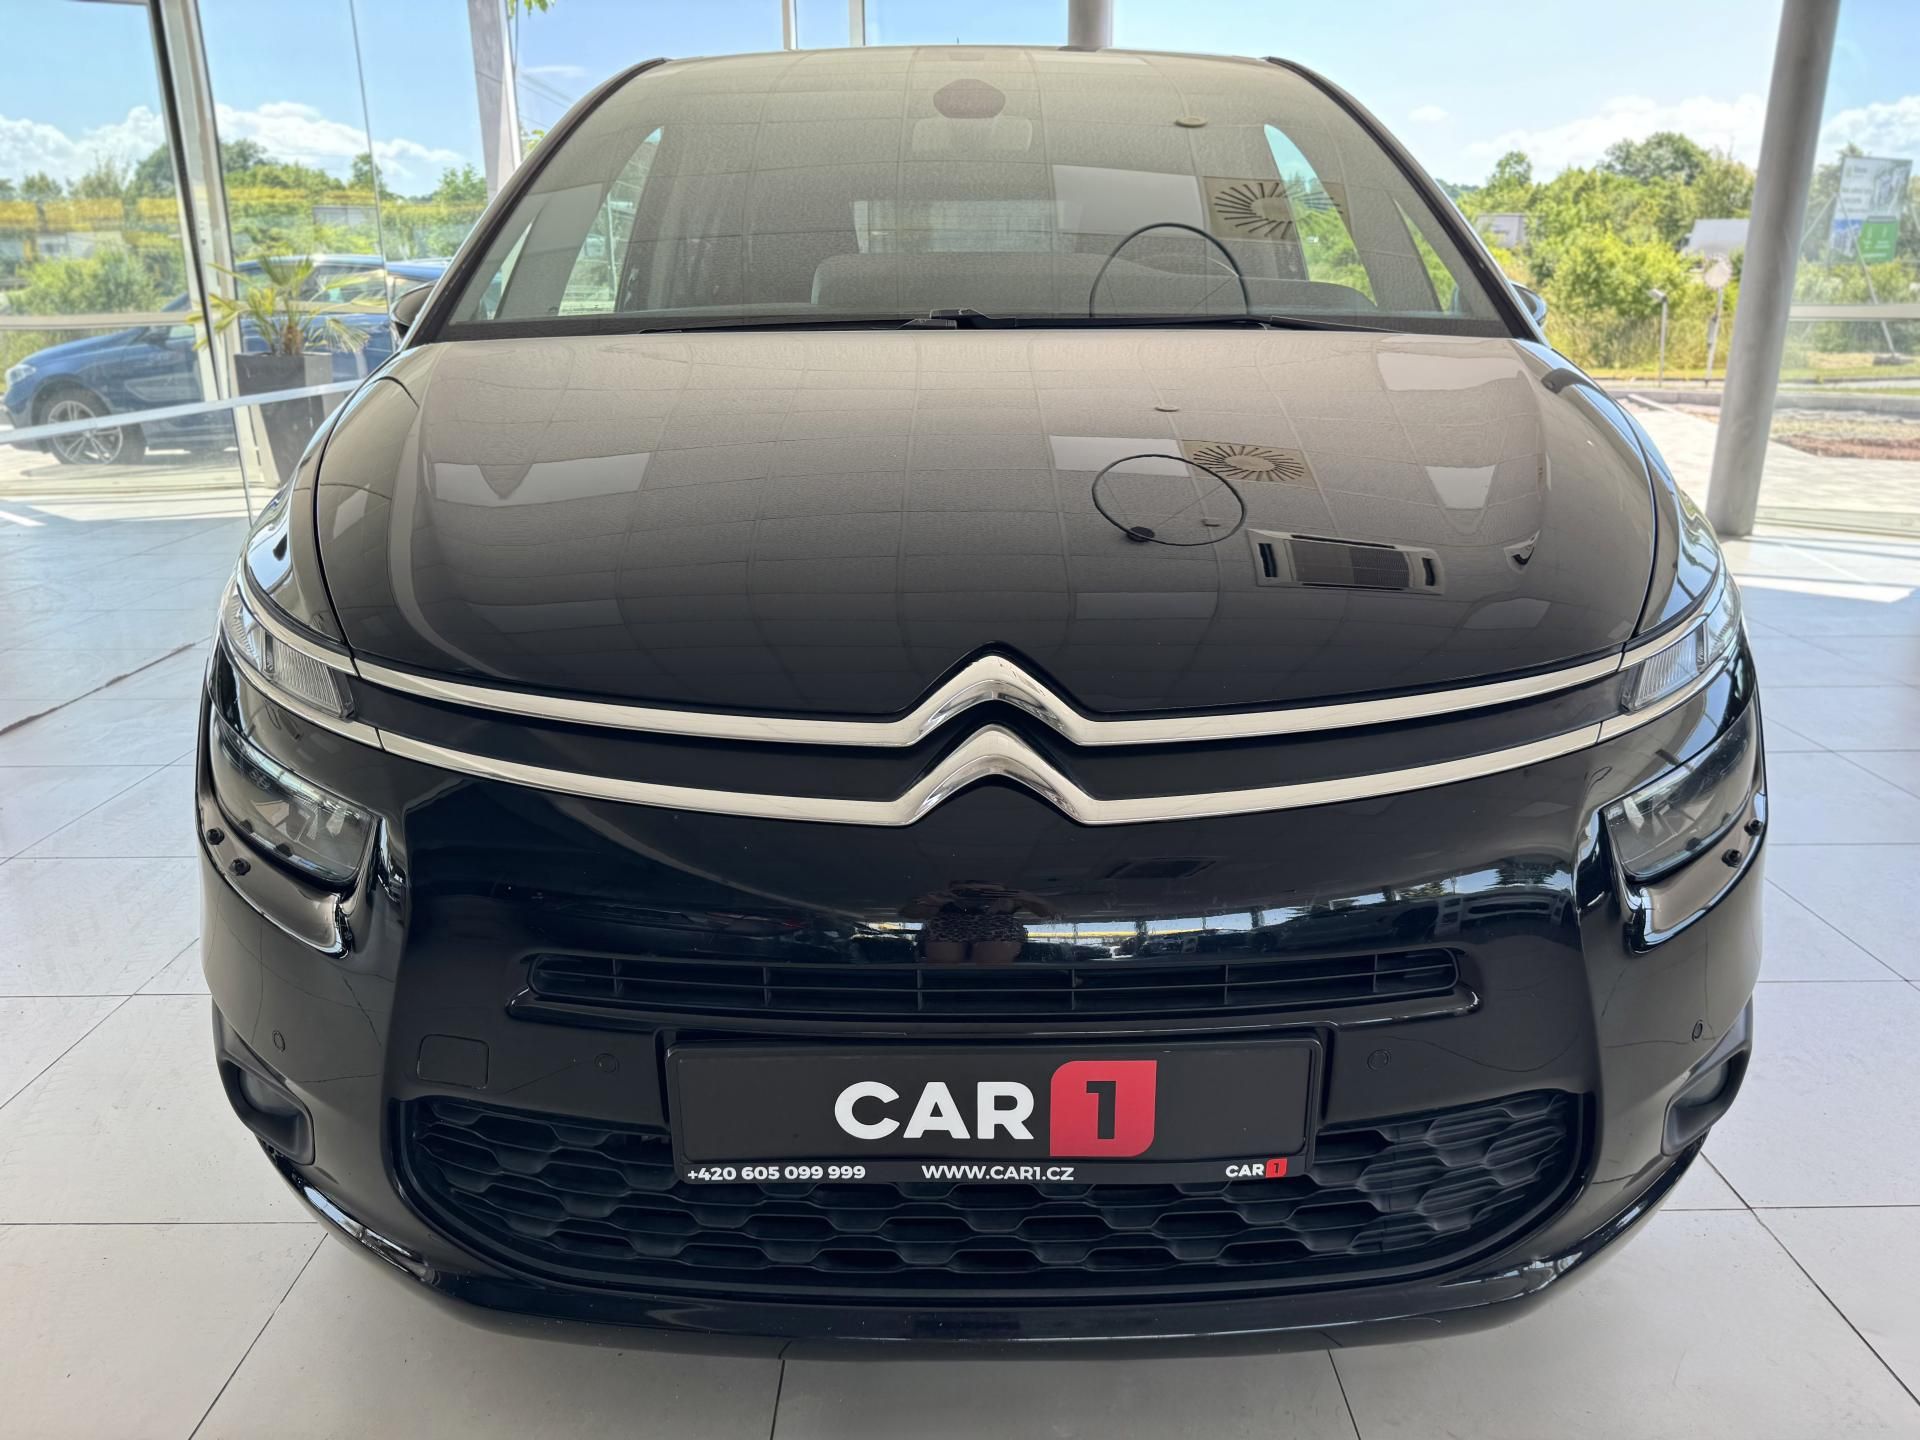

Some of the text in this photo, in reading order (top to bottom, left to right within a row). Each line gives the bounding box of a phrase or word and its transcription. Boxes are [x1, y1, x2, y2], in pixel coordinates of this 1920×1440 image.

[834, 1080, 1117, 1140] CAR 1
[687, 1165, 866, 1181] +420 605 099 999
[921, 1165, 1075, 1181] WWW.CAR1.CZ
[1225, 1163, 1265, 1178] CAR
